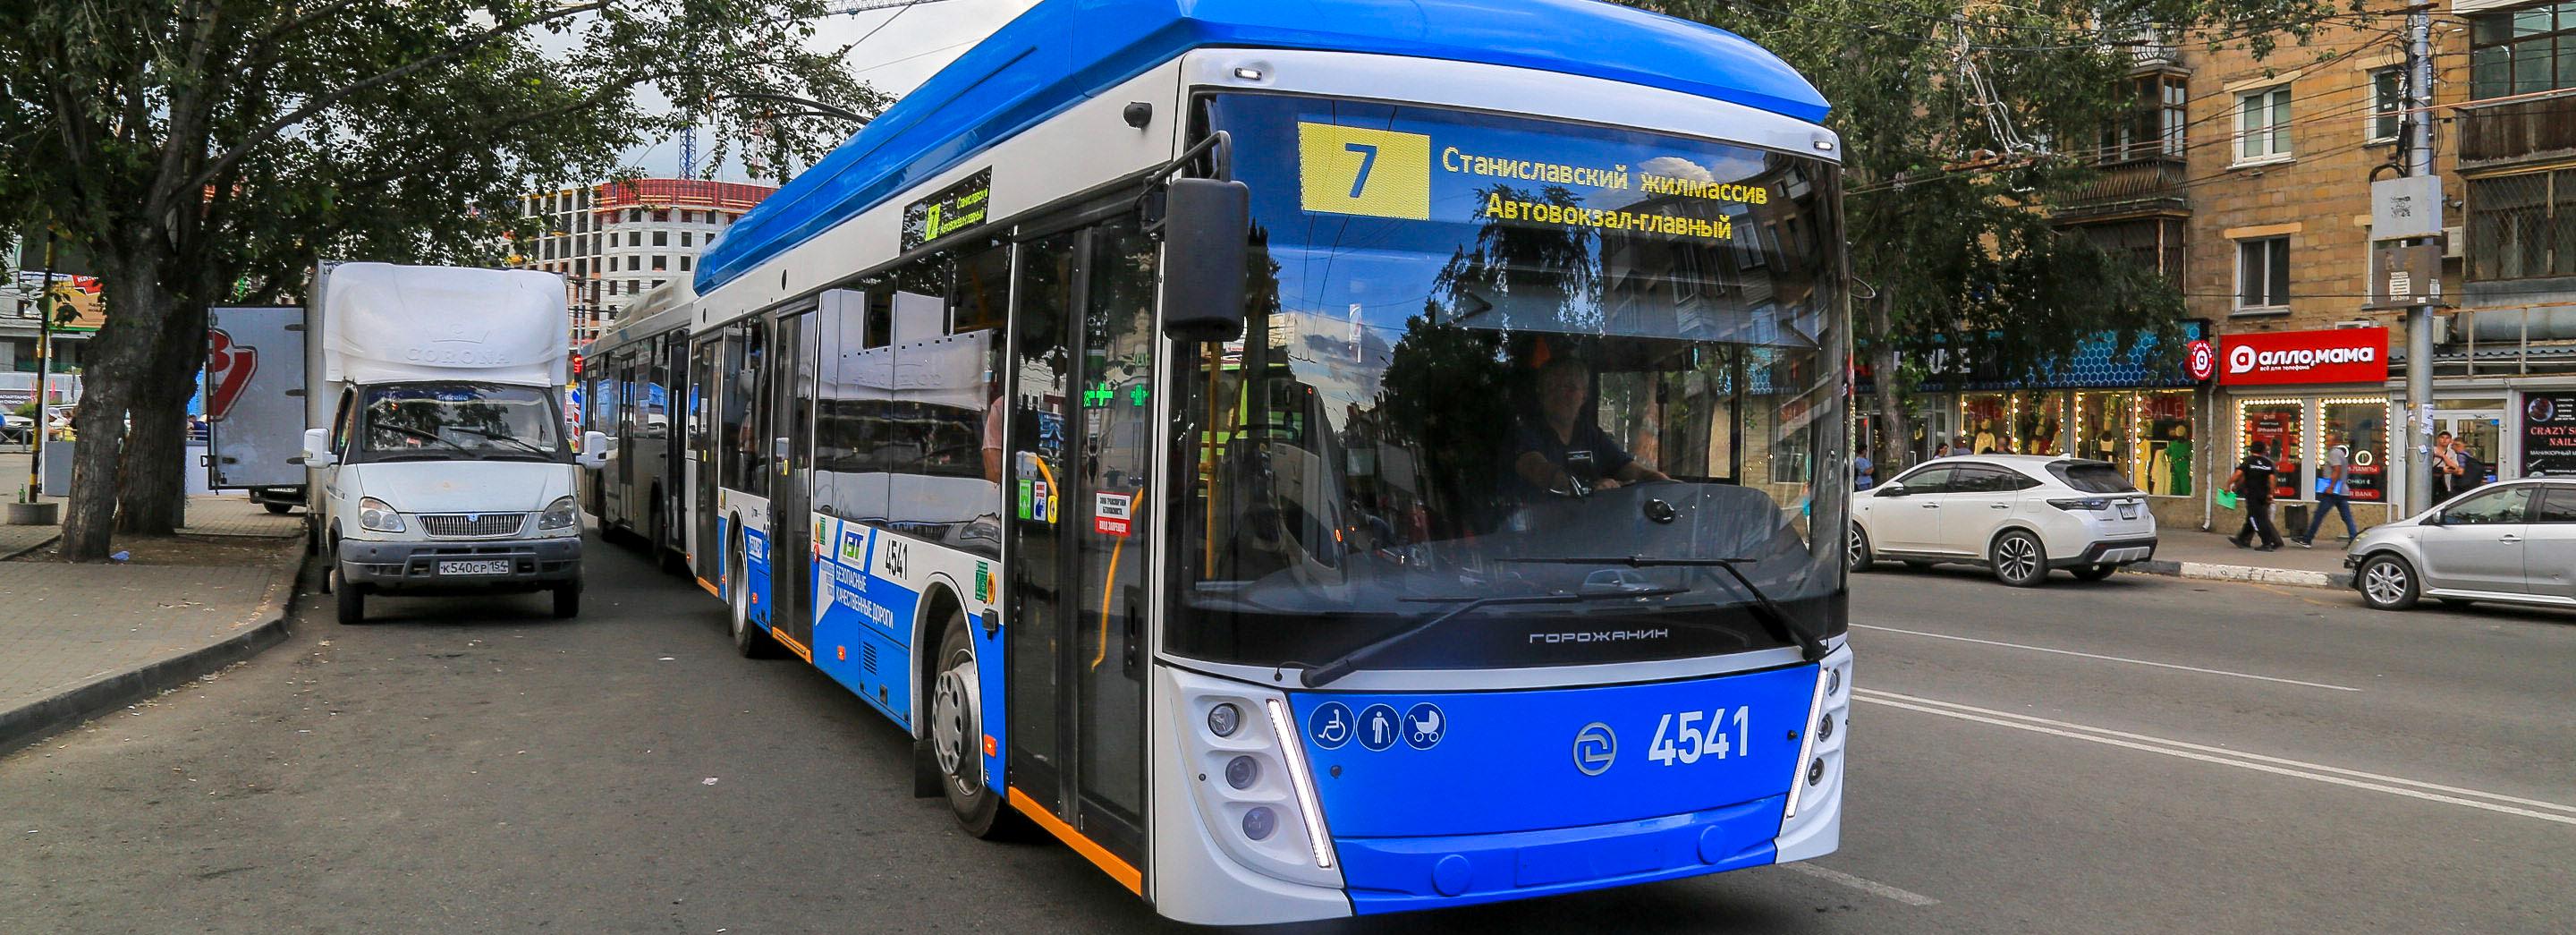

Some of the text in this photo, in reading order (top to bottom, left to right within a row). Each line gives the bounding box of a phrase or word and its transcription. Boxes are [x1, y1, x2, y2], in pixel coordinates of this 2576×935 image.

[1344, 142, 1377, 199] 7
[1442, 146, 1767, 205] Станиславский жилмассив
[1486, 192, 1732, 240] Автовокзал-главный
[406, 348, 511, 365] CORONA
[2530, 427, 2565, 435] CRAZY
[2549, 438, 2576, 446] NAILS
[489, 561, 509, 570] 154
[885, 539, 908, 581] 4541
[835, 565, 867, 593] БЕЗОПАСНЫЕ
[835, 585, 894, 629] КАЧЕСТВЕННЫЕ ДОРОГИ
[1530, 628, 1668, 644] ГОРОЖАНИН
[1648, 705, 1750, 767] 4541
